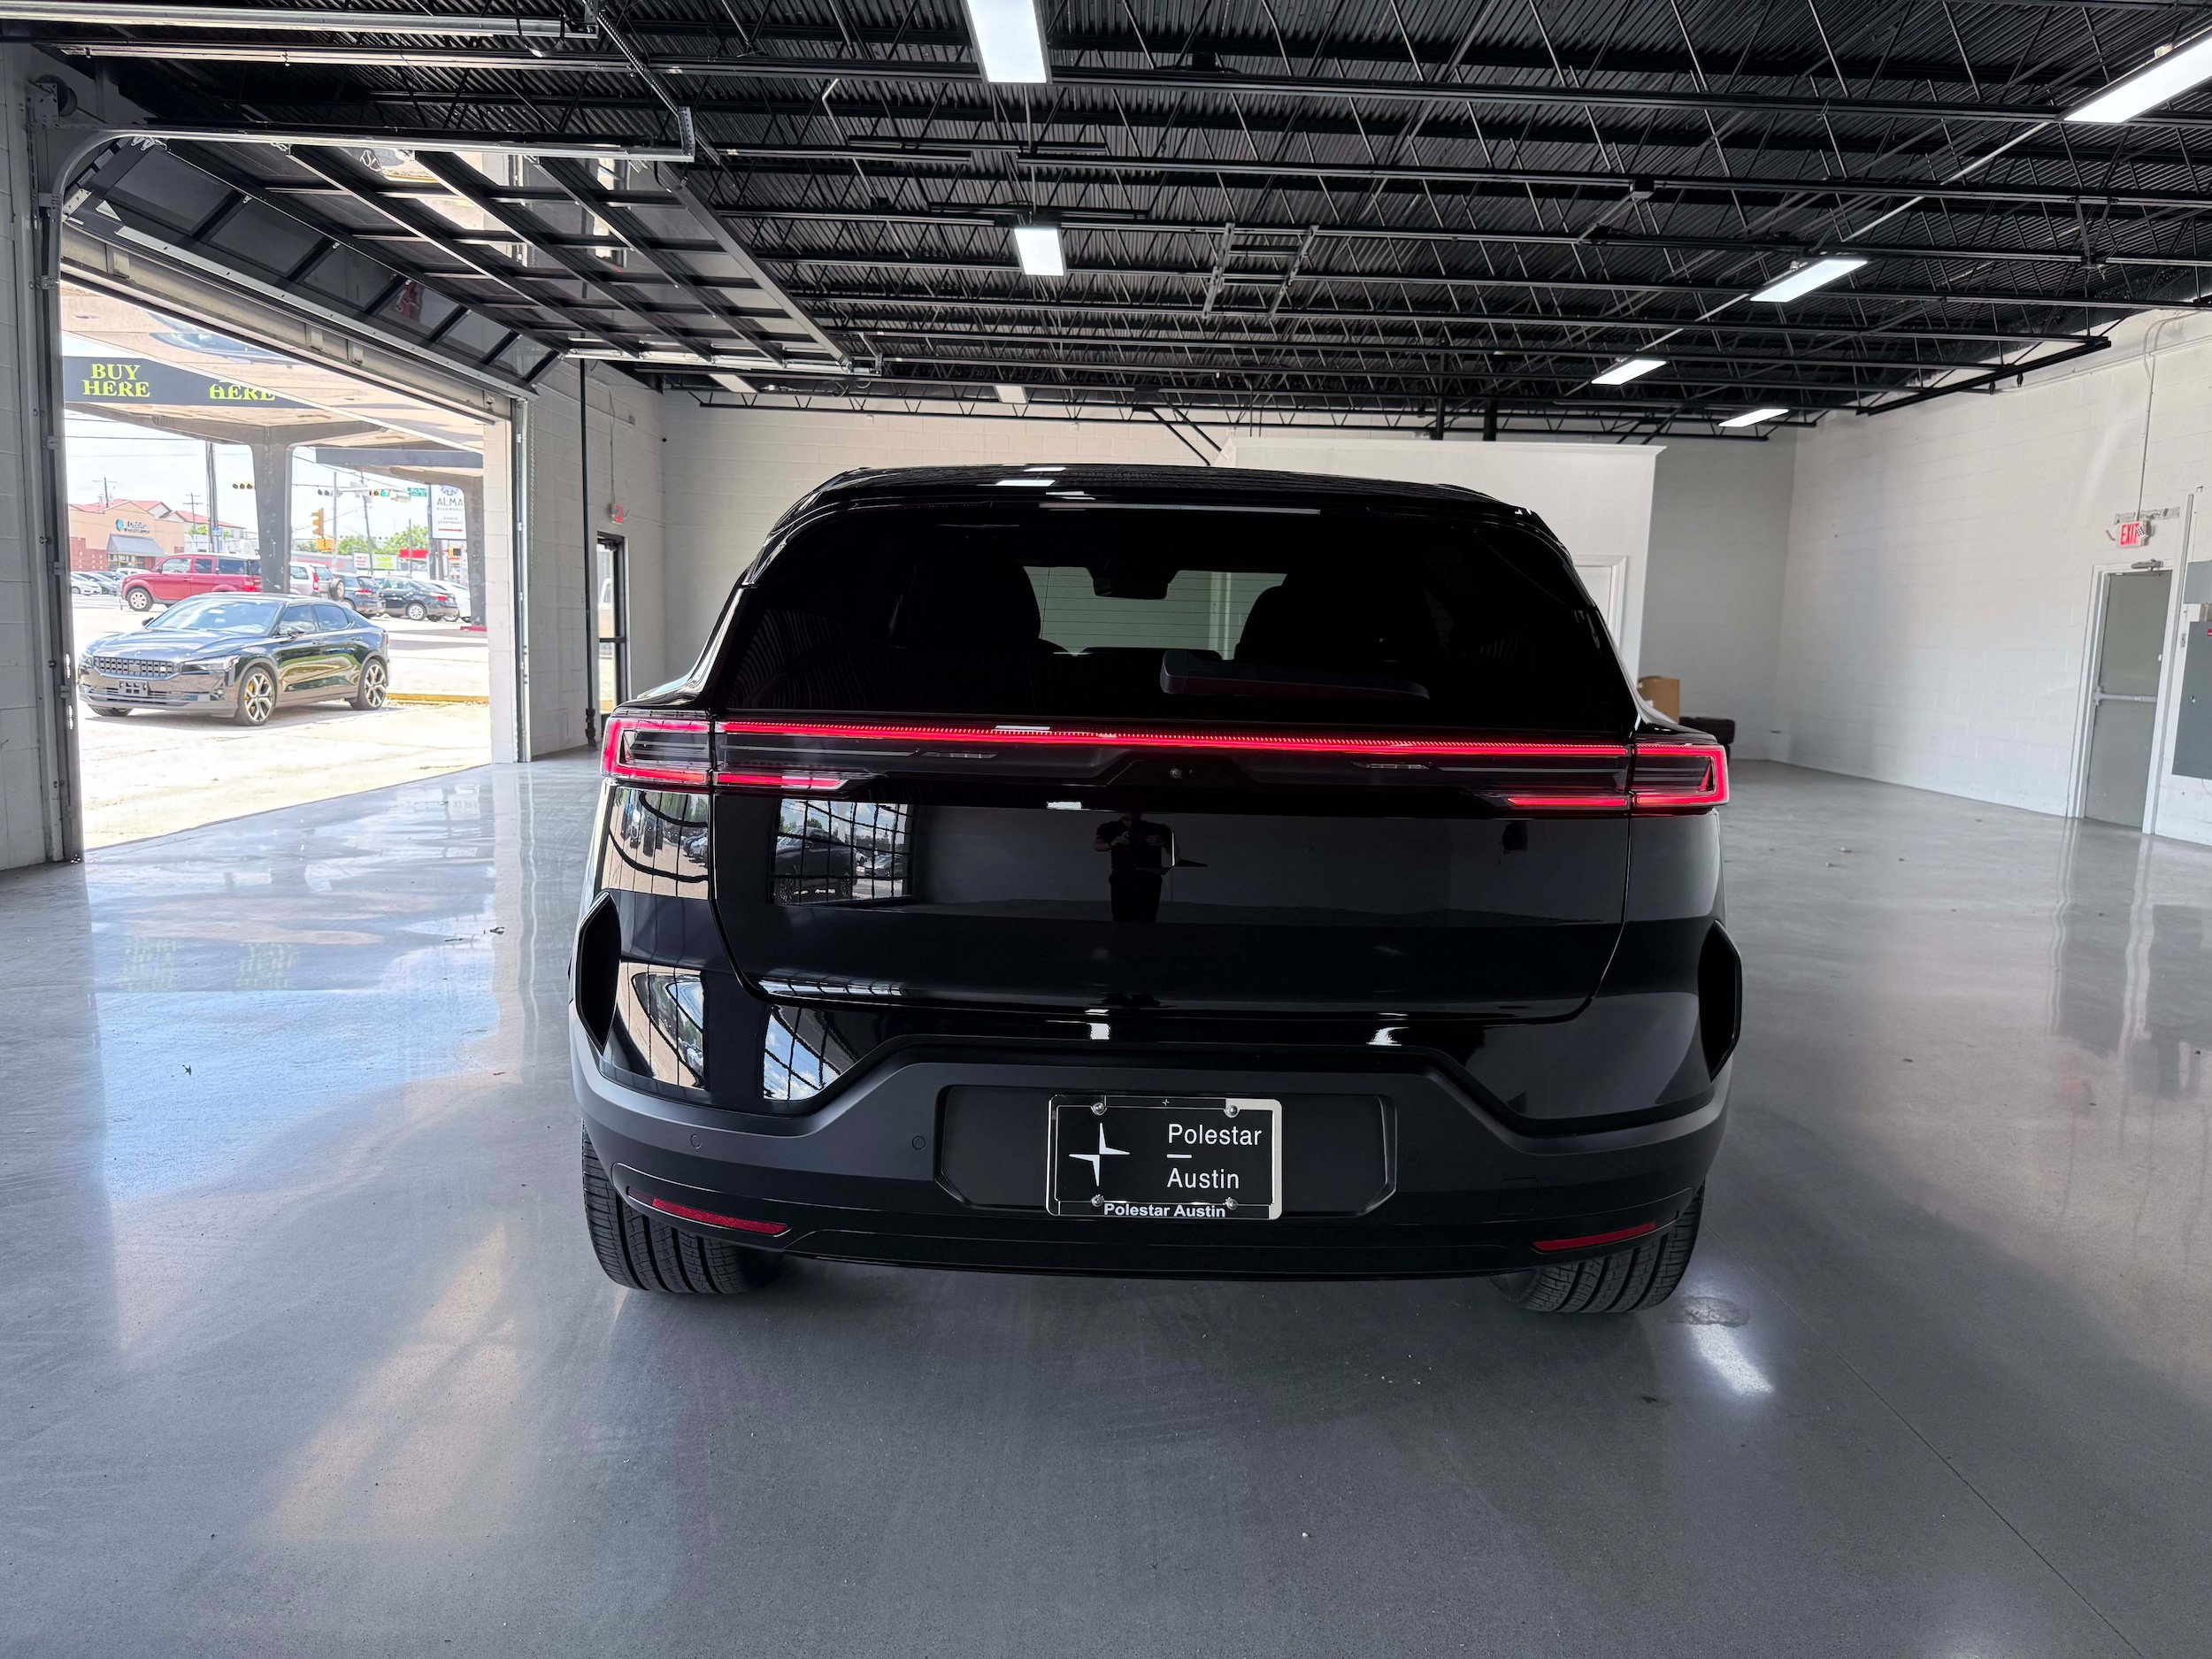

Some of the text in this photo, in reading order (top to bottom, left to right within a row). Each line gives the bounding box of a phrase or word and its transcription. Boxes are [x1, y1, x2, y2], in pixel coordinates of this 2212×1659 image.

[91, 364, 141, 380] BUY
[82, 380, 150, 398] HERE
[436, 497, 464, 506] ALMA
[2120, 523, 2140, 546] EXIT
[1167, 1123, 1262, 1146] Polestar
[1167, 1168, 1240, 1189] Austin
[1103, 1202, 1226, 1217] Polestar Austin
